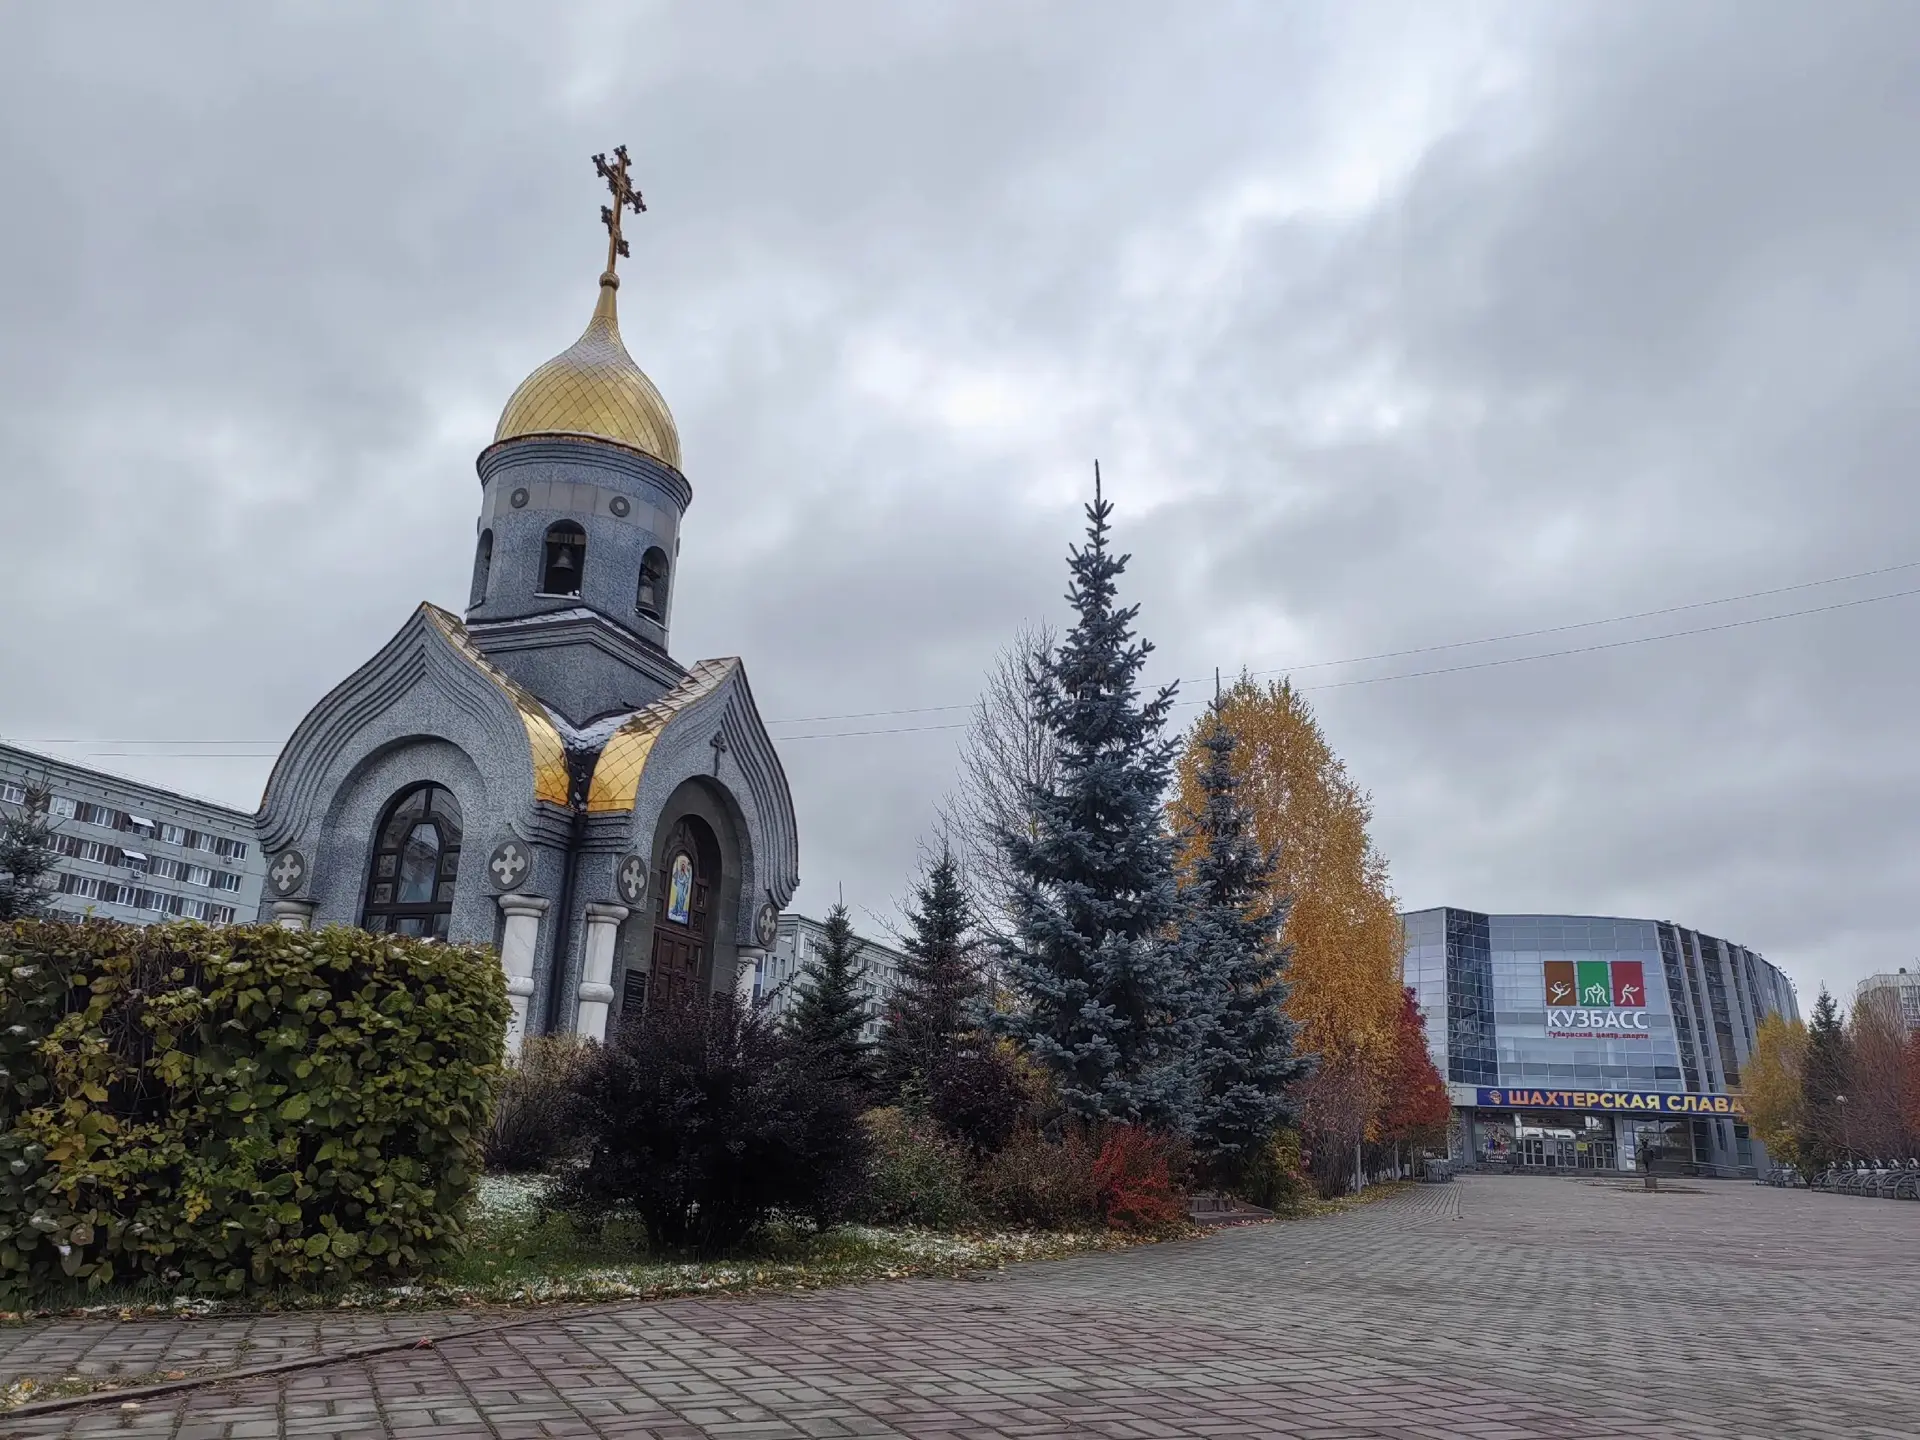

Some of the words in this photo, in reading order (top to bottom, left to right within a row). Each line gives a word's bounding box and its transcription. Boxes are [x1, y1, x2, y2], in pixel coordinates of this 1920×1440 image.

[1547, 1009, 1648, 1029] КУЗБАСС
[1596, 1032, 1618, 1040] центр
[1508, 1090, 1660, 1110] ШАХТЕРСКАЯ
[1666, 1095, 1746, 1113] СЛАВА
